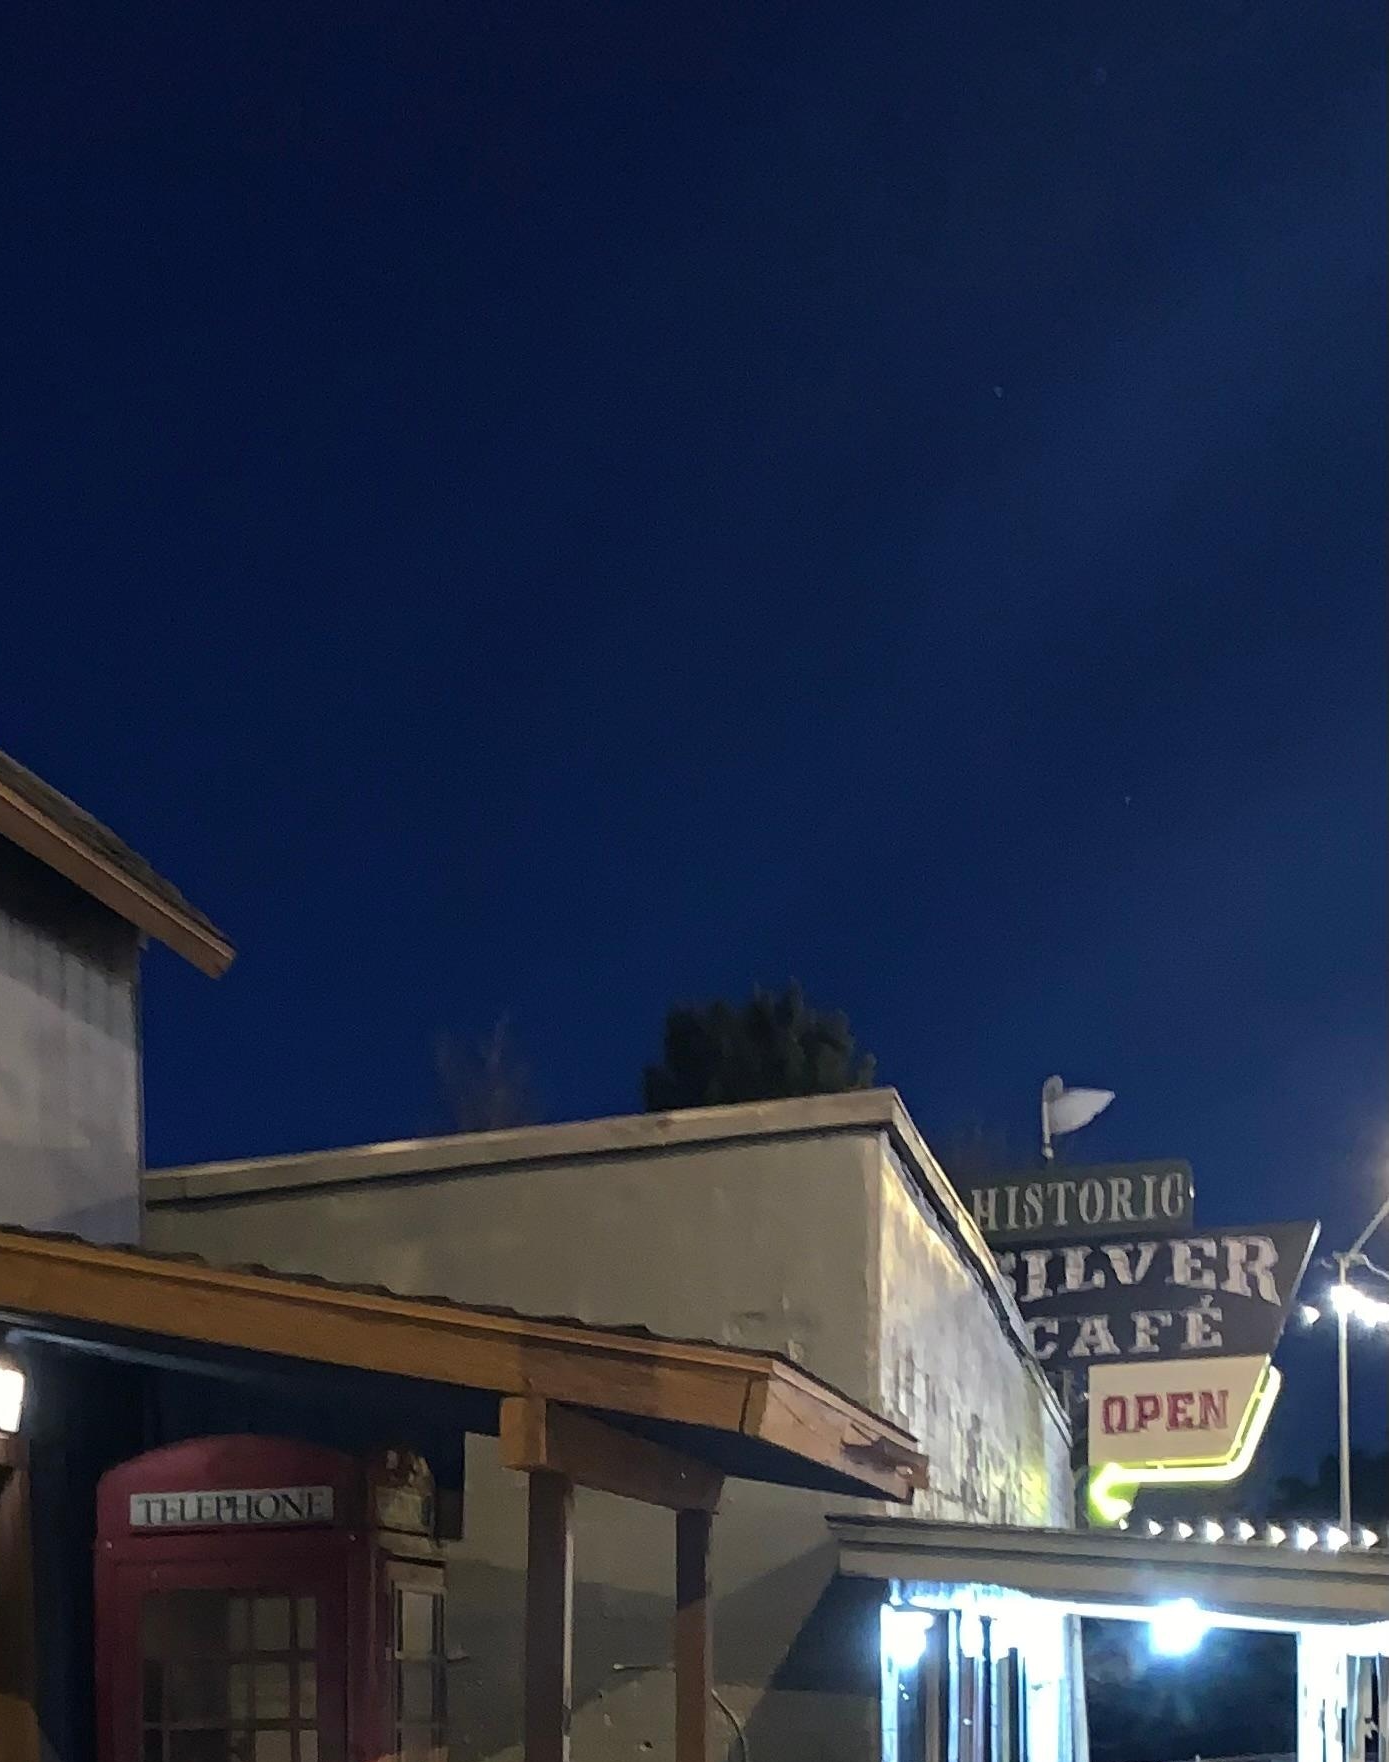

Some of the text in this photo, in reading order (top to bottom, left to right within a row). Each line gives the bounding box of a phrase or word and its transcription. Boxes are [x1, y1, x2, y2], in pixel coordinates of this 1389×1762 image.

[971, 1173, 1185, 1231] HISTORIC
[1025, 1295, 1223, 1359] CAFÉ
[1101, 1390, 1229, 1434] OPEN
[136, 1490, 326, 1525] TELEPHONE
